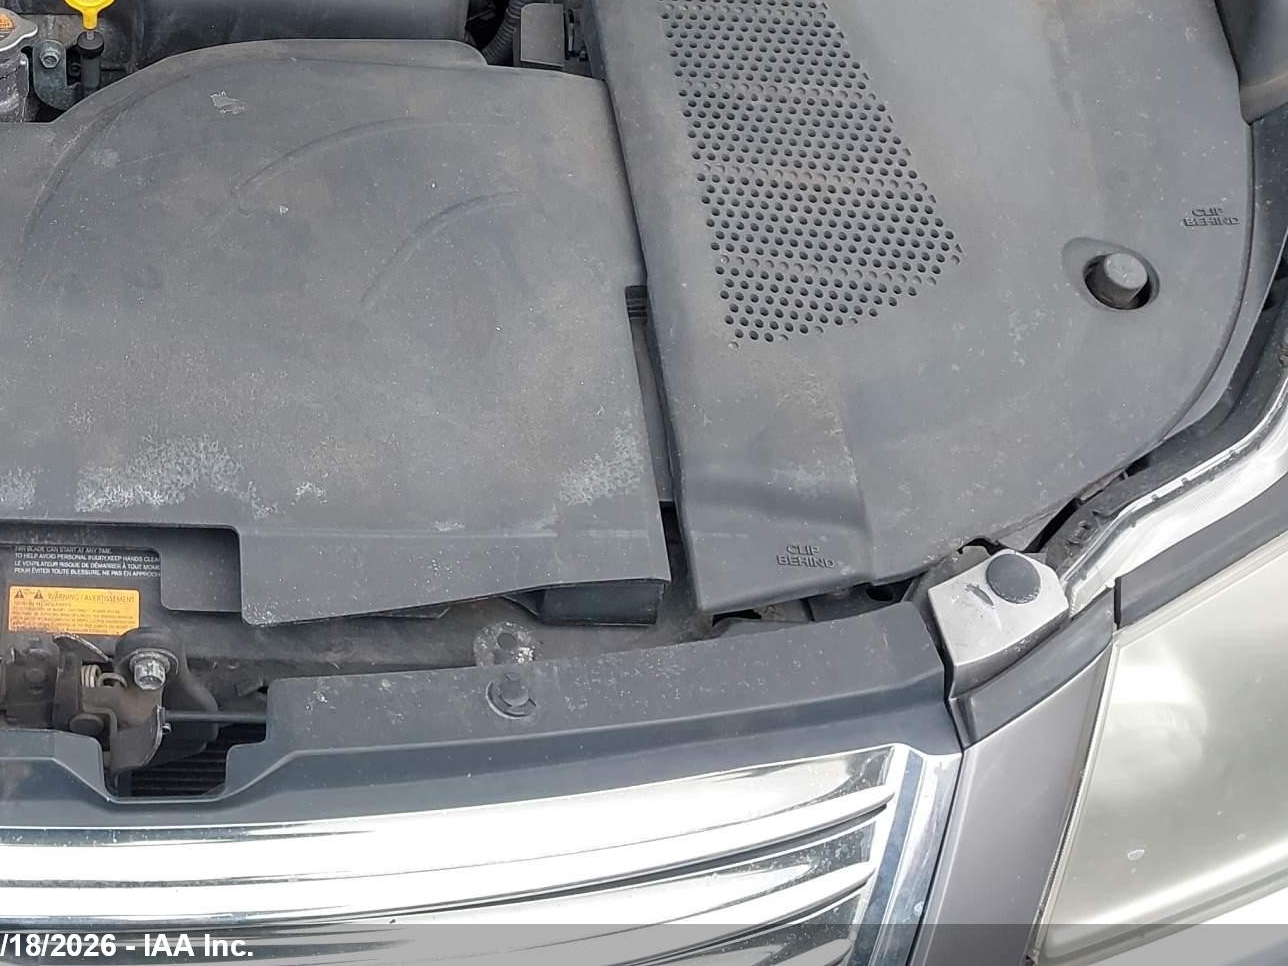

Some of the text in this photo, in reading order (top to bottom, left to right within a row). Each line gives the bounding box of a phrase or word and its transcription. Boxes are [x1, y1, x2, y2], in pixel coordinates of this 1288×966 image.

[1192, 208, 1224, 217] CLIP
[1183, 217, 1240, 227] BEHIND
[786, 545, 819, 555] CLIP
[776, 555, 835, 568] BEHIND
